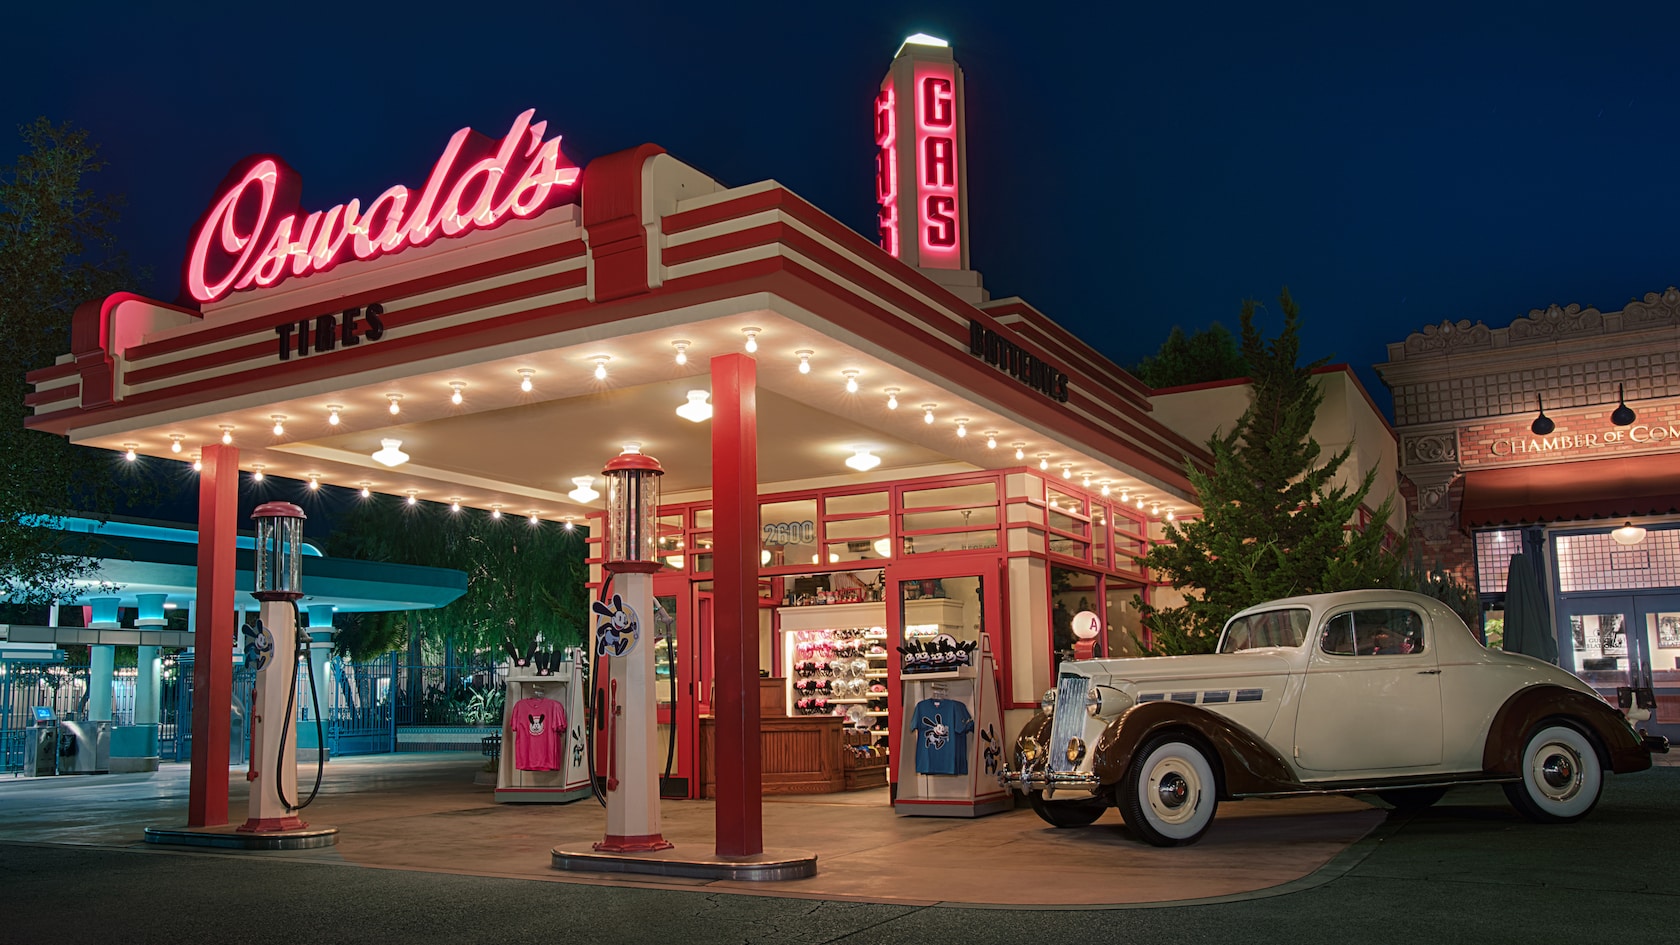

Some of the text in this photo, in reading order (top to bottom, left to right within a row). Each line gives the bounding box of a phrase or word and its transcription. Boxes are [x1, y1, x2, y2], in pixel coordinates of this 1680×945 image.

[922, 77, 955, 247] GAS
[188, 108, 581, 301] Oswald's
[275, 302, 385, 361] TIRES
[969, 319, 1069, 402] BATTERIES
[1491, 433, 1598, 457] CHAMBER
[763, 520, 814, 546] 2600
[1089, 617, 1098, 631] A
